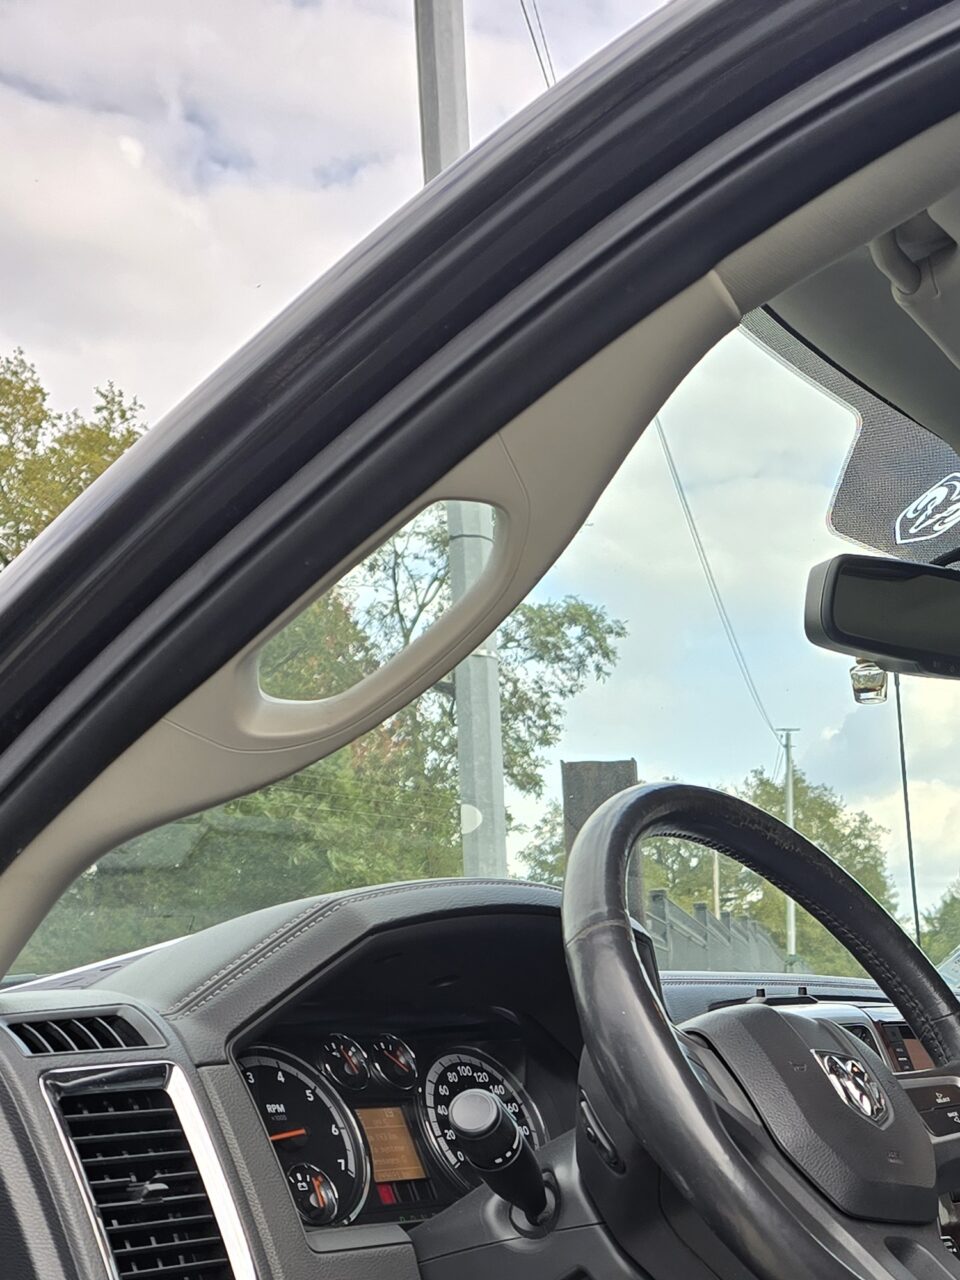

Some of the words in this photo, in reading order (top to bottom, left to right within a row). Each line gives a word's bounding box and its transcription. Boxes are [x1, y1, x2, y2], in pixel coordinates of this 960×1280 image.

[457, 1066, 472, 1076] 100
[246, 1072, 254, 1083] 3
[277, 1071, 284, 1083] 4
[447, 1072, 458, 1082] 80
[473, 1072, 489, 1082] 120
[438, 1085, 449, 1095] 60
[489, 1084, 505, 1095] 140
[305, 1090, 314, 1101] 5
[266, 1104, 286, 1113] RPM
[437, 1105, 448, 1115] 40
[331, 1124, 340, 1136] 6
[444, 1129, 456, 1140] 20
[456, 1151, 464, 1161] 0
[337, 1159, 345, 1171] 7
